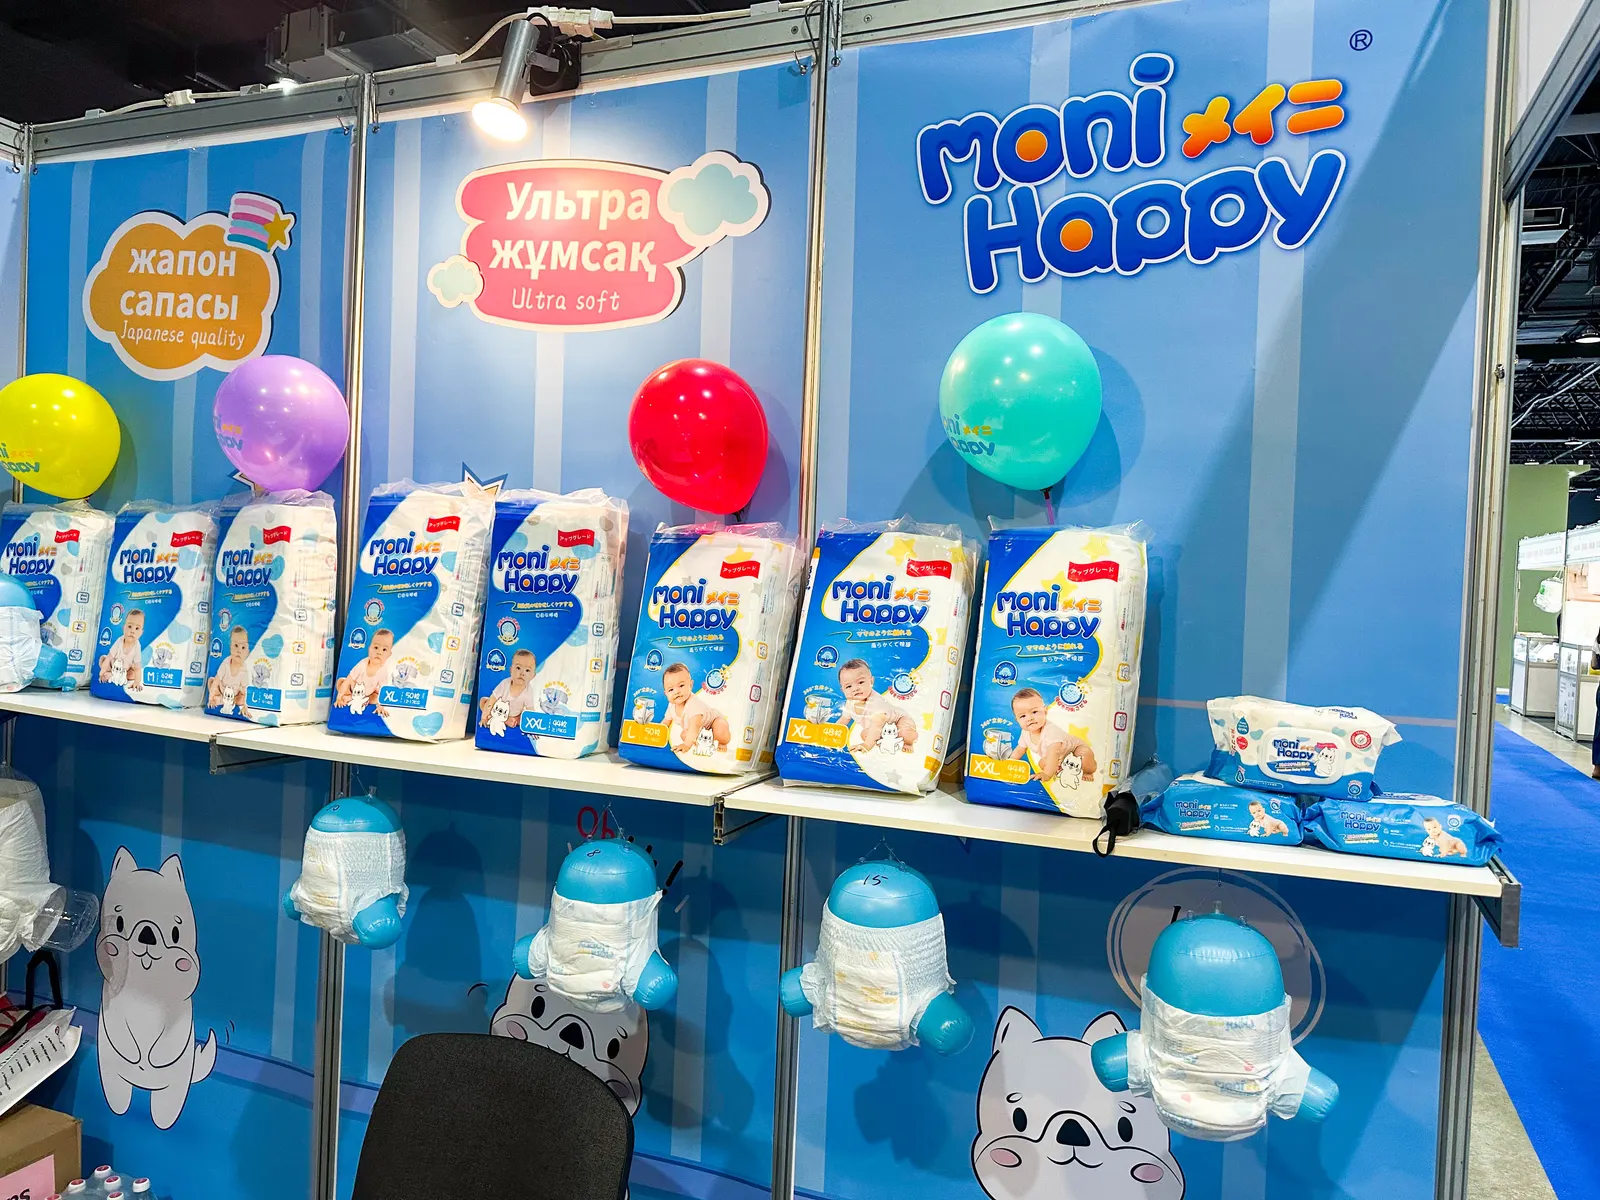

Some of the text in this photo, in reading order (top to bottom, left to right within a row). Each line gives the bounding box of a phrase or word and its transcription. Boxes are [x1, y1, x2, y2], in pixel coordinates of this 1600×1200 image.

[917, 52, 1345, 204] moni メイニ
[505, 181, 651, 231] Ультра
[963, 148, 1346, 294] Happy
[128, 248, 237, 277] жапон
[489, 238, 656, 282] жұмсақ
[120, 290, 239, 321] сапасы
[512, 287, 620, 314] Ultra soft
[121, 320, 245, 350] Japanese quality
[6, 536, 38, 557] moni
[119, 542, 157, 565] moni
[222, 542, 255, 567] moni
[369, 530, 416, 556] moni
[8, 557, 55, 576] Happy
[373, 555, 438, 576] Happy
[497, 544, 550, 570] moni
[123, 564, 177, 584] Happy
[225, 566, 272, 588] Happy
[504, 569, 578, 594] Happy
[652, 577, 707, 605] moni
[832, 574, 895, 600] moni
[996, 583, 1061, 612] moni
[659, 604, 737, 630] Happy
[840, 600, 928, 625] Happy
[1007, 612, 1100, 639] Happy
[147, 671, 155, 682] M
[252, 692, 258, 703] L
[383, 689, 398, 702] XL
[525, 717, 547, 730] XXL
[627, 725, 635, 739] L
[791, 723, 812, 739] XL
[1272, 737, 1300, 750] moni
[1276, 748, 1315, 760] Happy
[974, 759, 1001, 776] XXL
[1174, 798, 1199, 809] moni
[1179, 807, 1211, 818] Happy
[1340, 809, 1367, 821] moni
[1344, 819, 1381, 832] Happy
